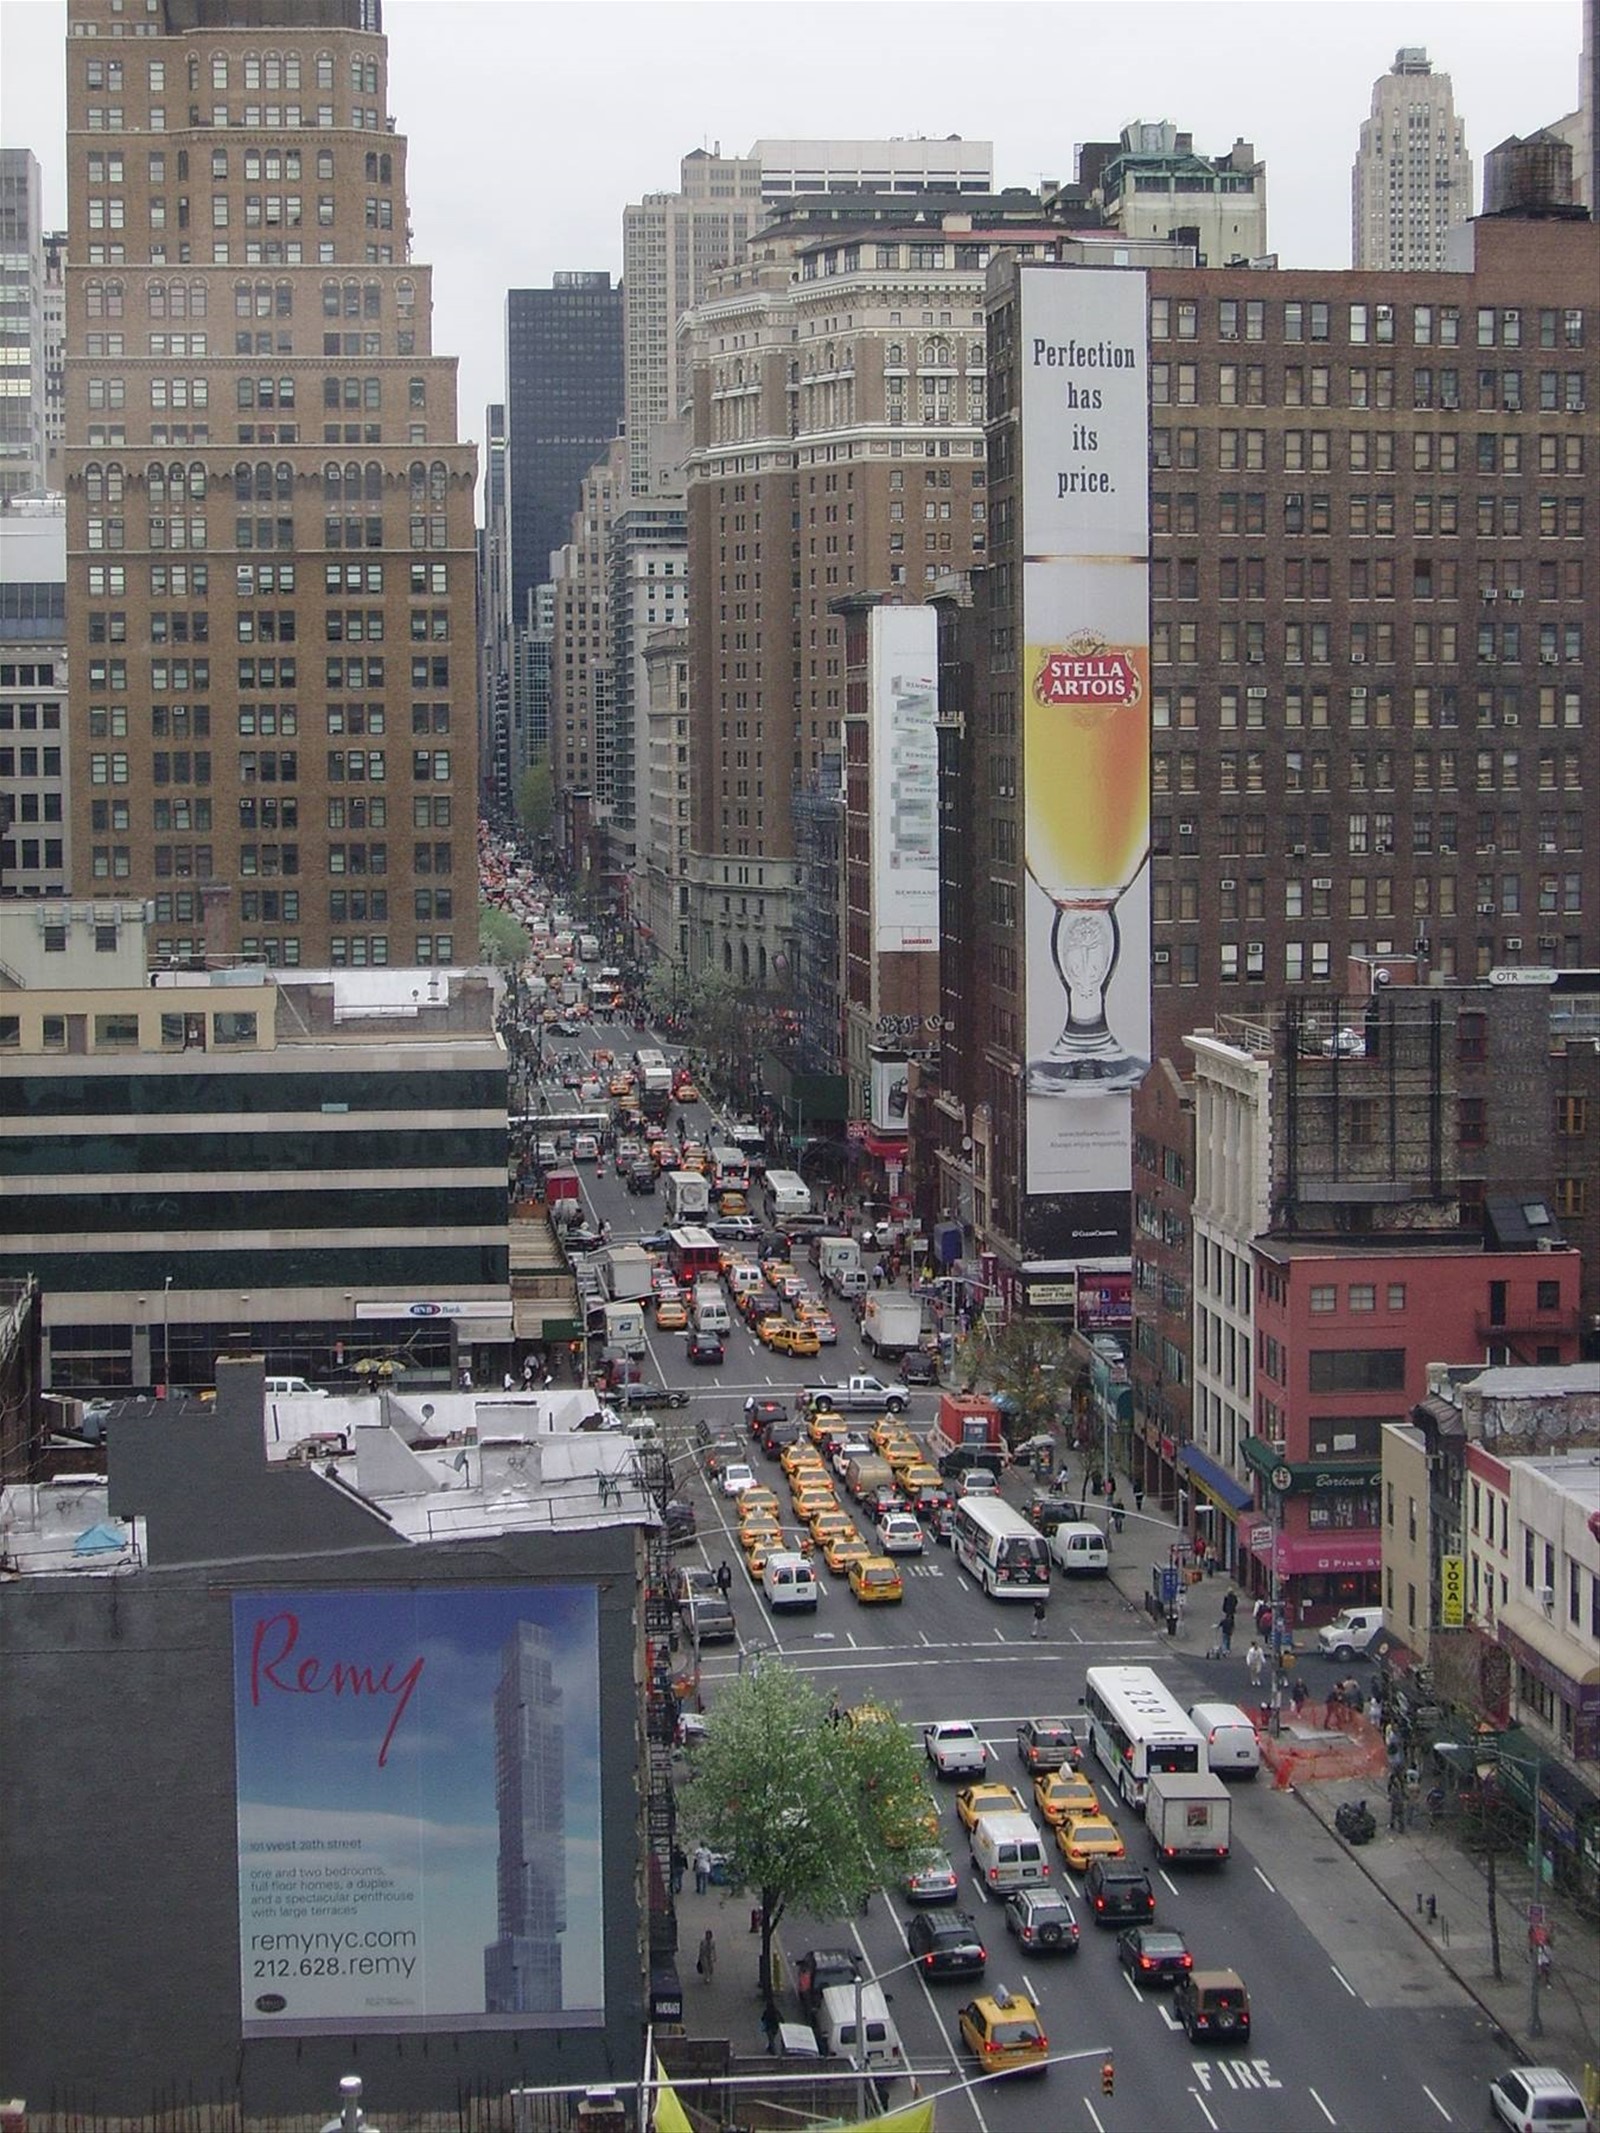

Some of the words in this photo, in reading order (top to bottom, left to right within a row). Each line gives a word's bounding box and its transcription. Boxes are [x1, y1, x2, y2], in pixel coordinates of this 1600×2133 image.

[1033, 339, 1136, 369] Perfection
[1067, 382, 1103, 409] has
[1072, 424, 1098, 451] its
[1057, 465, 1116, 498] price.
[1051, 661, 1124, 677] STELLA
[1051, 680, 1126, 696] ARTOIS
[1497, 972, 1518, 981] OTR
[442, 1306, 461, 1314] Bank
[1447, 1561, 1459, 1601] YOGA
[251, 1610, 425, 1768] Remy
[326, 1838, 362, 1850] street
[250, 1869, 272, 1880] one
[274, 1867, 297, 1879] and
[299, 1867, 322, 1878] two
[250, 1881, 269, 1892] full
[271, 1880, 298, 1892] floor
[300, 1879, 344, 1892] homes,
[346, 1881, 354, 1890] a
[356, 1878, 395, 1891] duplex
[250, 1893, 272, 1905] and
[274, 1896, 282, 1905] a
[285, 1892, 350, 1906] spectacular
[352, 1891, 414, 1904] penthouse
[251, 1907, 277, 1918] with
[279, 1906, 308, 1919] large
[311, 1905, 358, 1917] terraces
[251, 1930, 417, 1954] remynyc.com
[253, 1956, 417, 1979] 212.628.remy
[1191, 2059, 1283, 2092] FIRE
